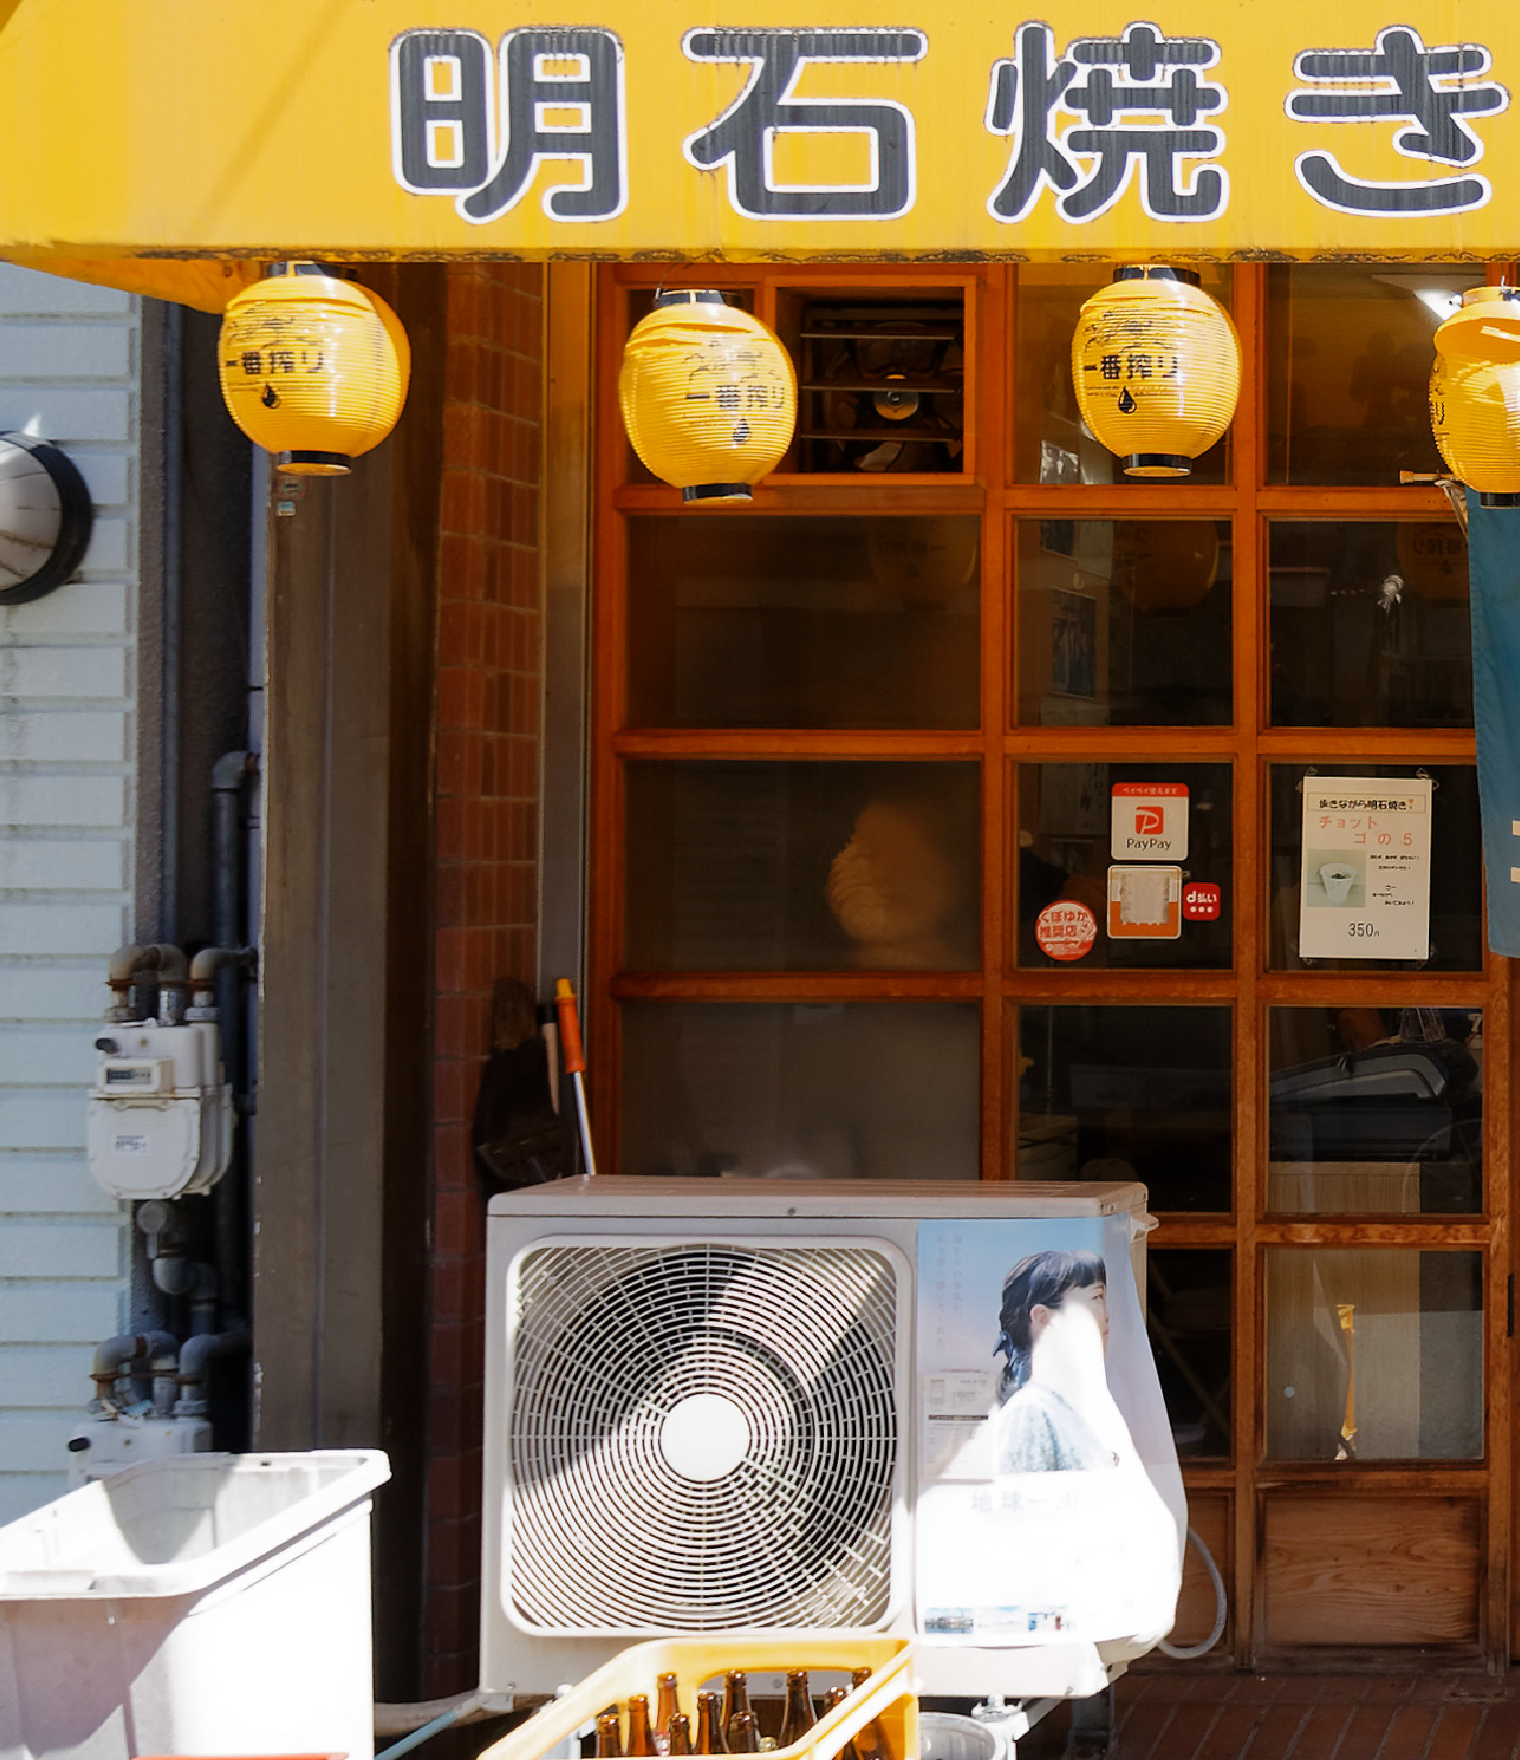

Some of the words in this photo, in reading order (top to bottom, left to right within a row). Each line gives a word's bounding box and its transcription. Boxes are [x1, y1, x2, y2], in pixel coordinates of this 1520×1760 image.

[388, 20, 1512, 228] 明石焼き
[1083, 353, 1179, 381] 一番搾り
[1126, 838, 1172, 851] PayPay
